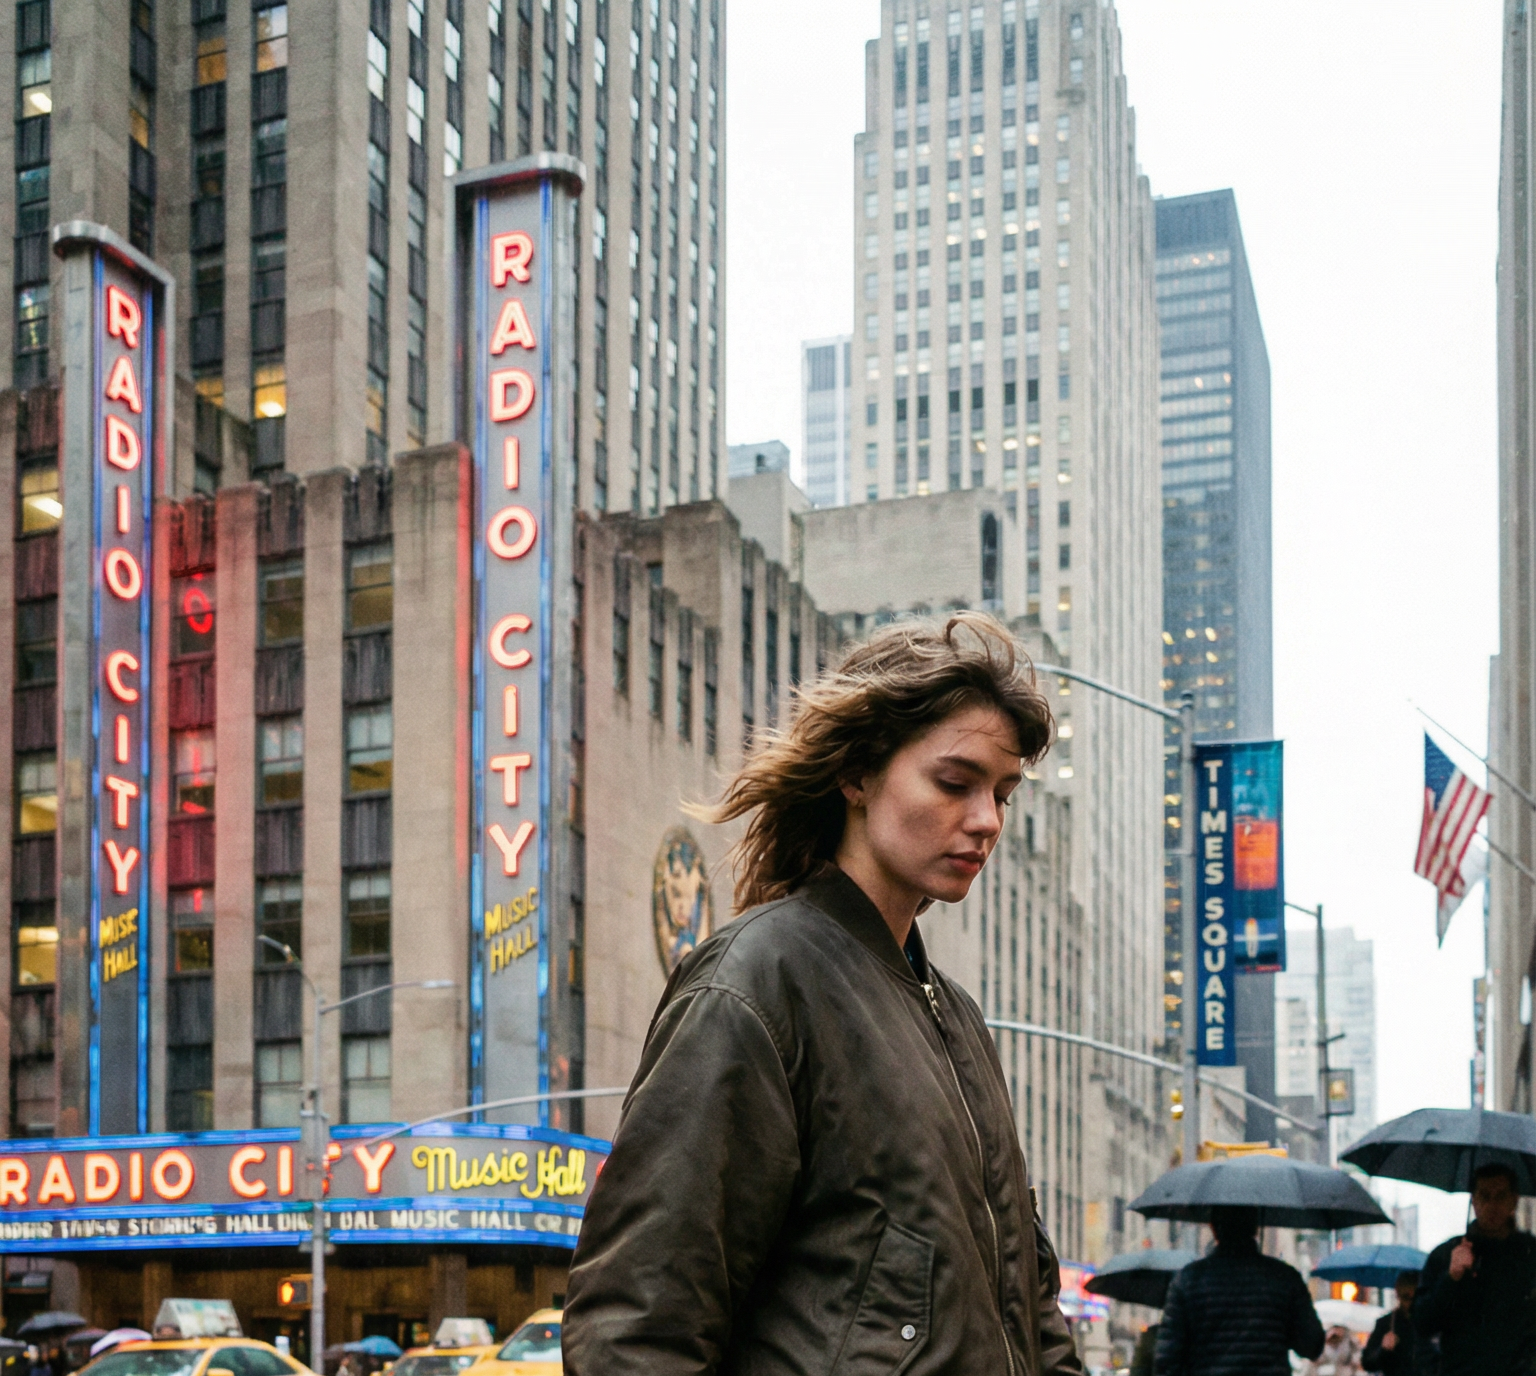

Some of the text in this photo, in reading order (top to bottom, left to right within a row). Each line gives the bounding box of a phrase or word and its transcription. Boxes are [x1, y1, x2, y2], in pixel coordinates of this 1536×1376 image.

[103, 284, 143, 895] RADIO CITY
[486, 230, 538, 877] RADIO CITY
[489, 924, 538, 975] HALL
[1201, 759, 1228, 1050] TIMES SQUARE
[0, 1148, 195, 1206] RADIO
[411, 1144, 529, 1193] Music
[519, 1144, 587, 1199] Hall
[390, 1209, 460, 1229] MUSIC
[470, 1210, 527, 1231] HALL
